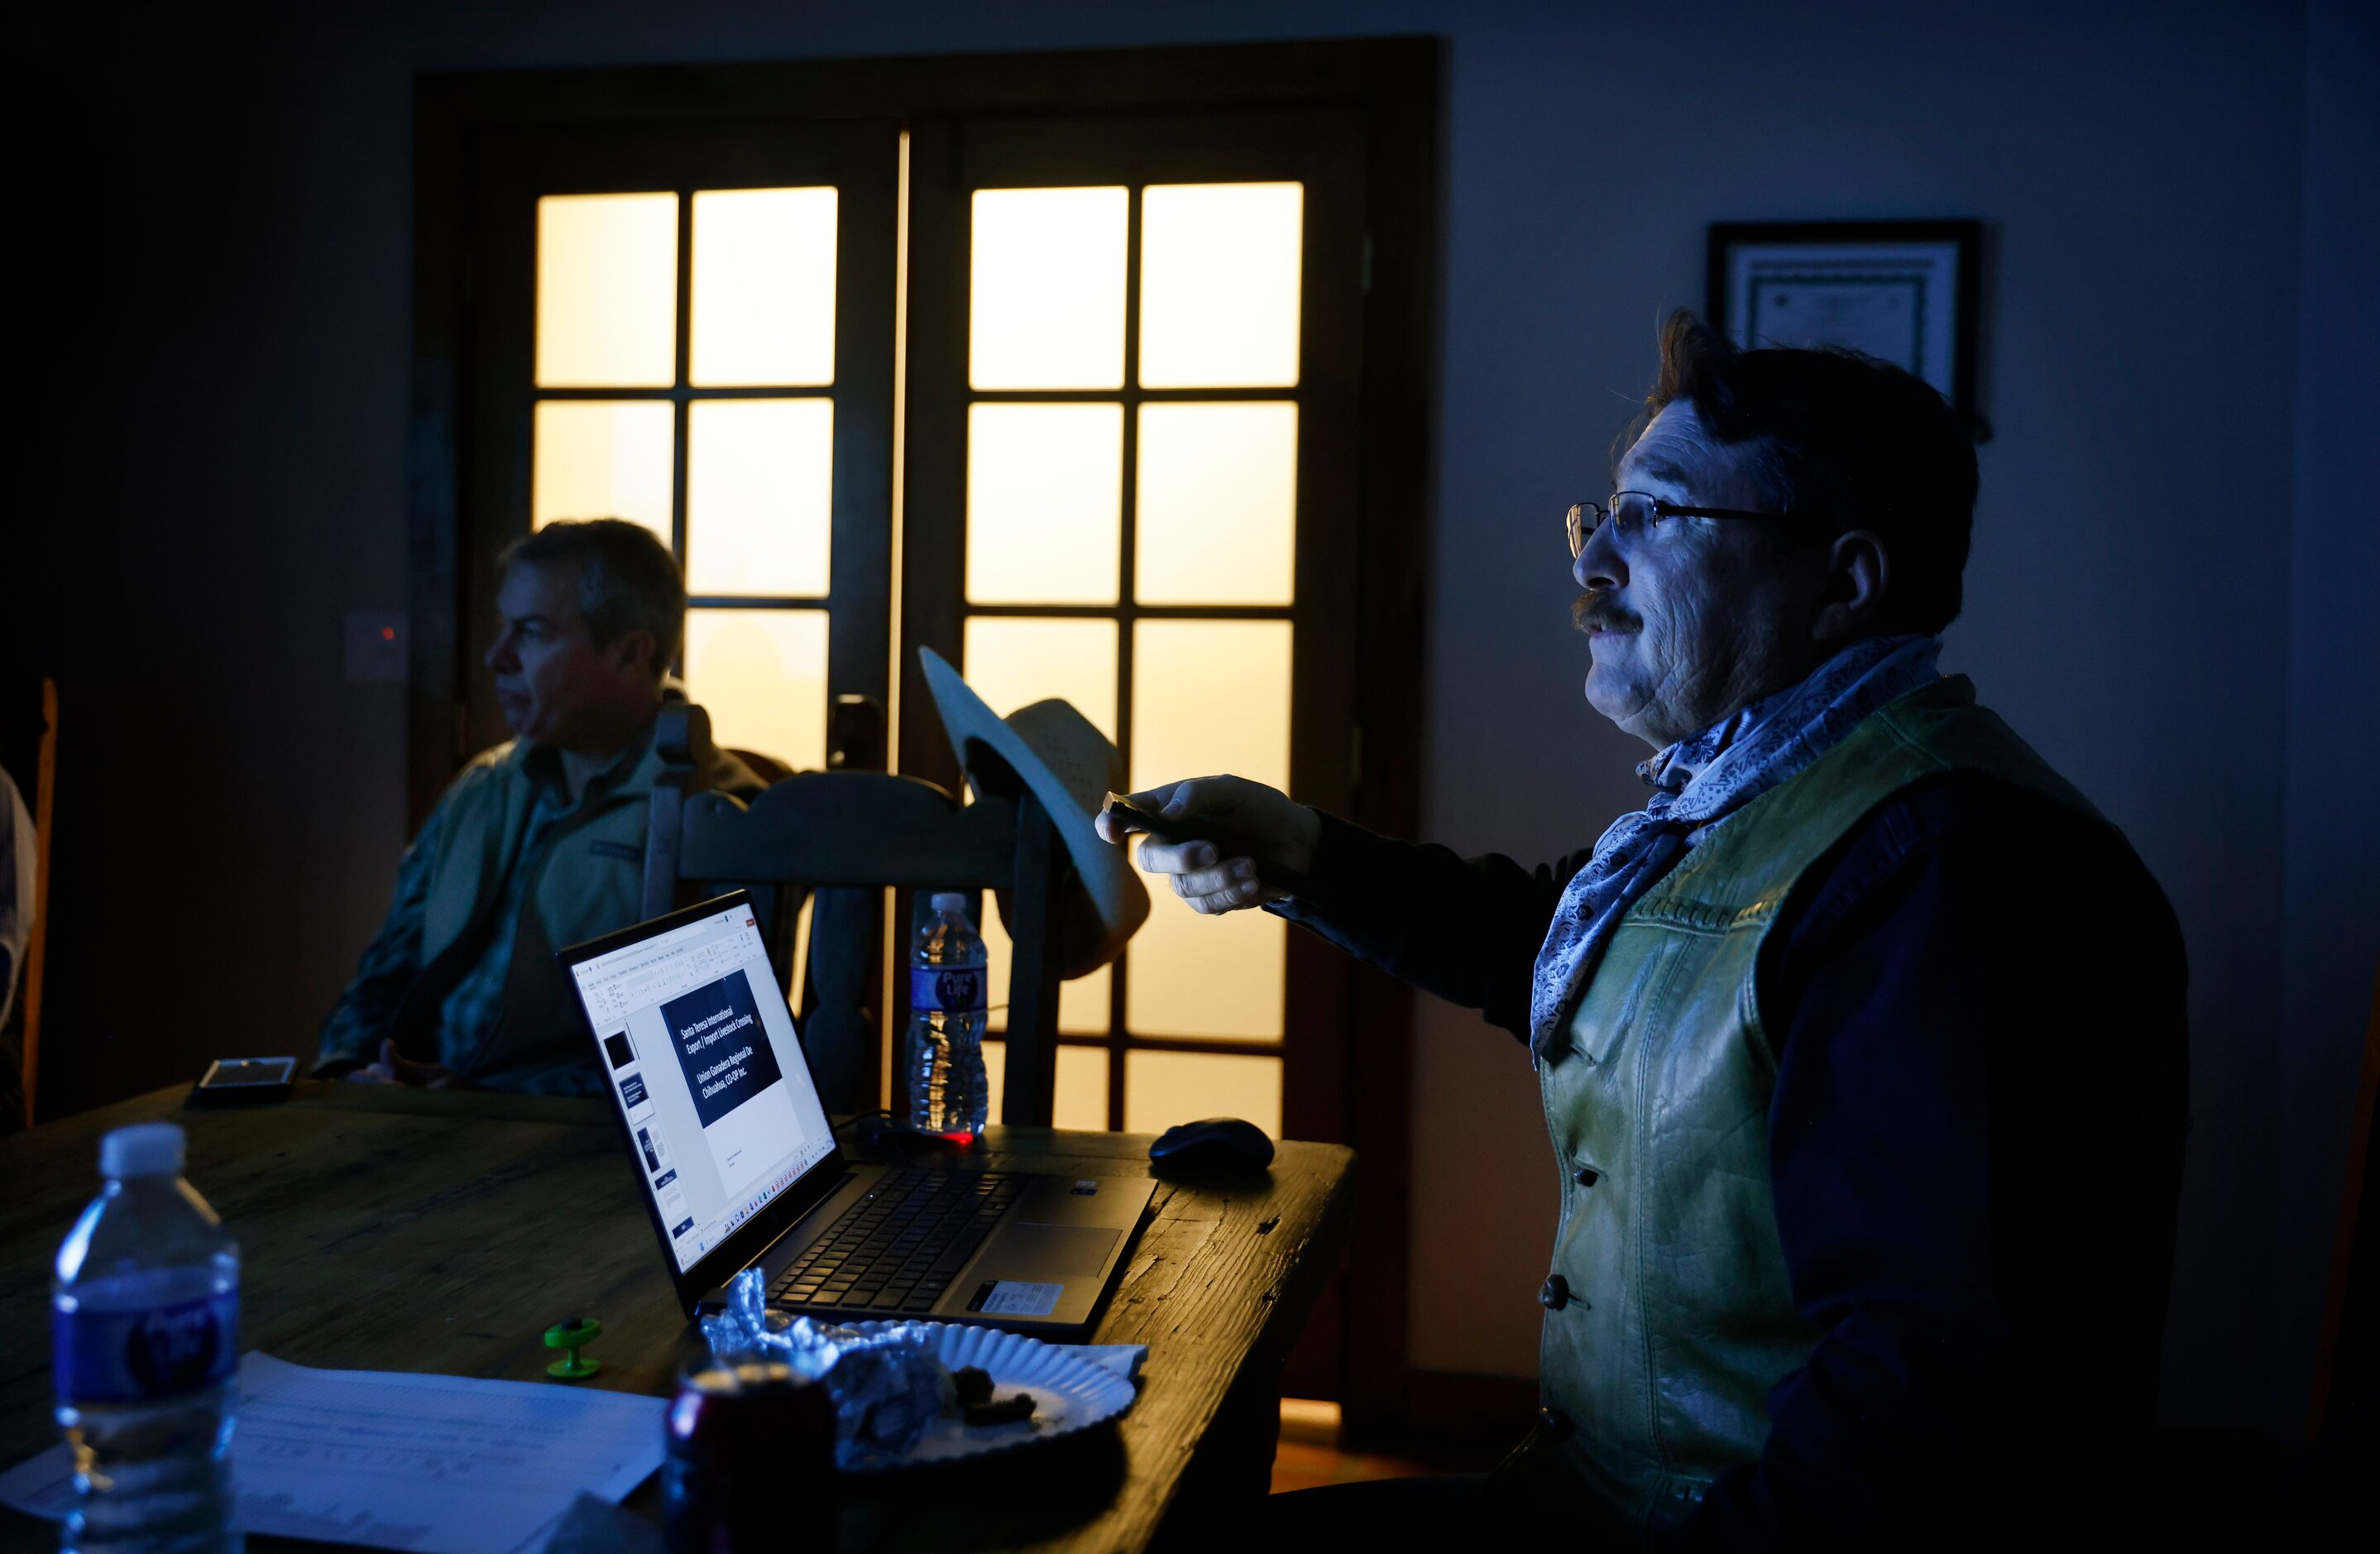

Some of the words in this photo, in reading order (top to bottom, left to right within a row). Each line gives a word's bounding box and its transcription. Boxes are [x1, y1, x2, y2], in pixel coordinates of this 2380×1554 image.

[681, 1026, 695, 1039] Santa
[692, 1020, 708, 1033] Teresa
[706, 1005, 733, 1026] International
[687, 1039, 702, 1054] Export
[703, 1030, 720, 1045] Import
[717, 1020, 737, 1038] Livestock
[735, 1014, 753, 1029] Crossing
[697, 1071, 711, 1084] Union
[711, 1060, 730, 1076] Ganadera
[729, 1047, 747, 1065] Regional
[745, 1046, 753, 1056] De
[702, 1080, 727, 1099] Chihuahua,
[725, 1070, 739, 1085] CO-OP
[738, 1067, 747, 1077] Inc.
